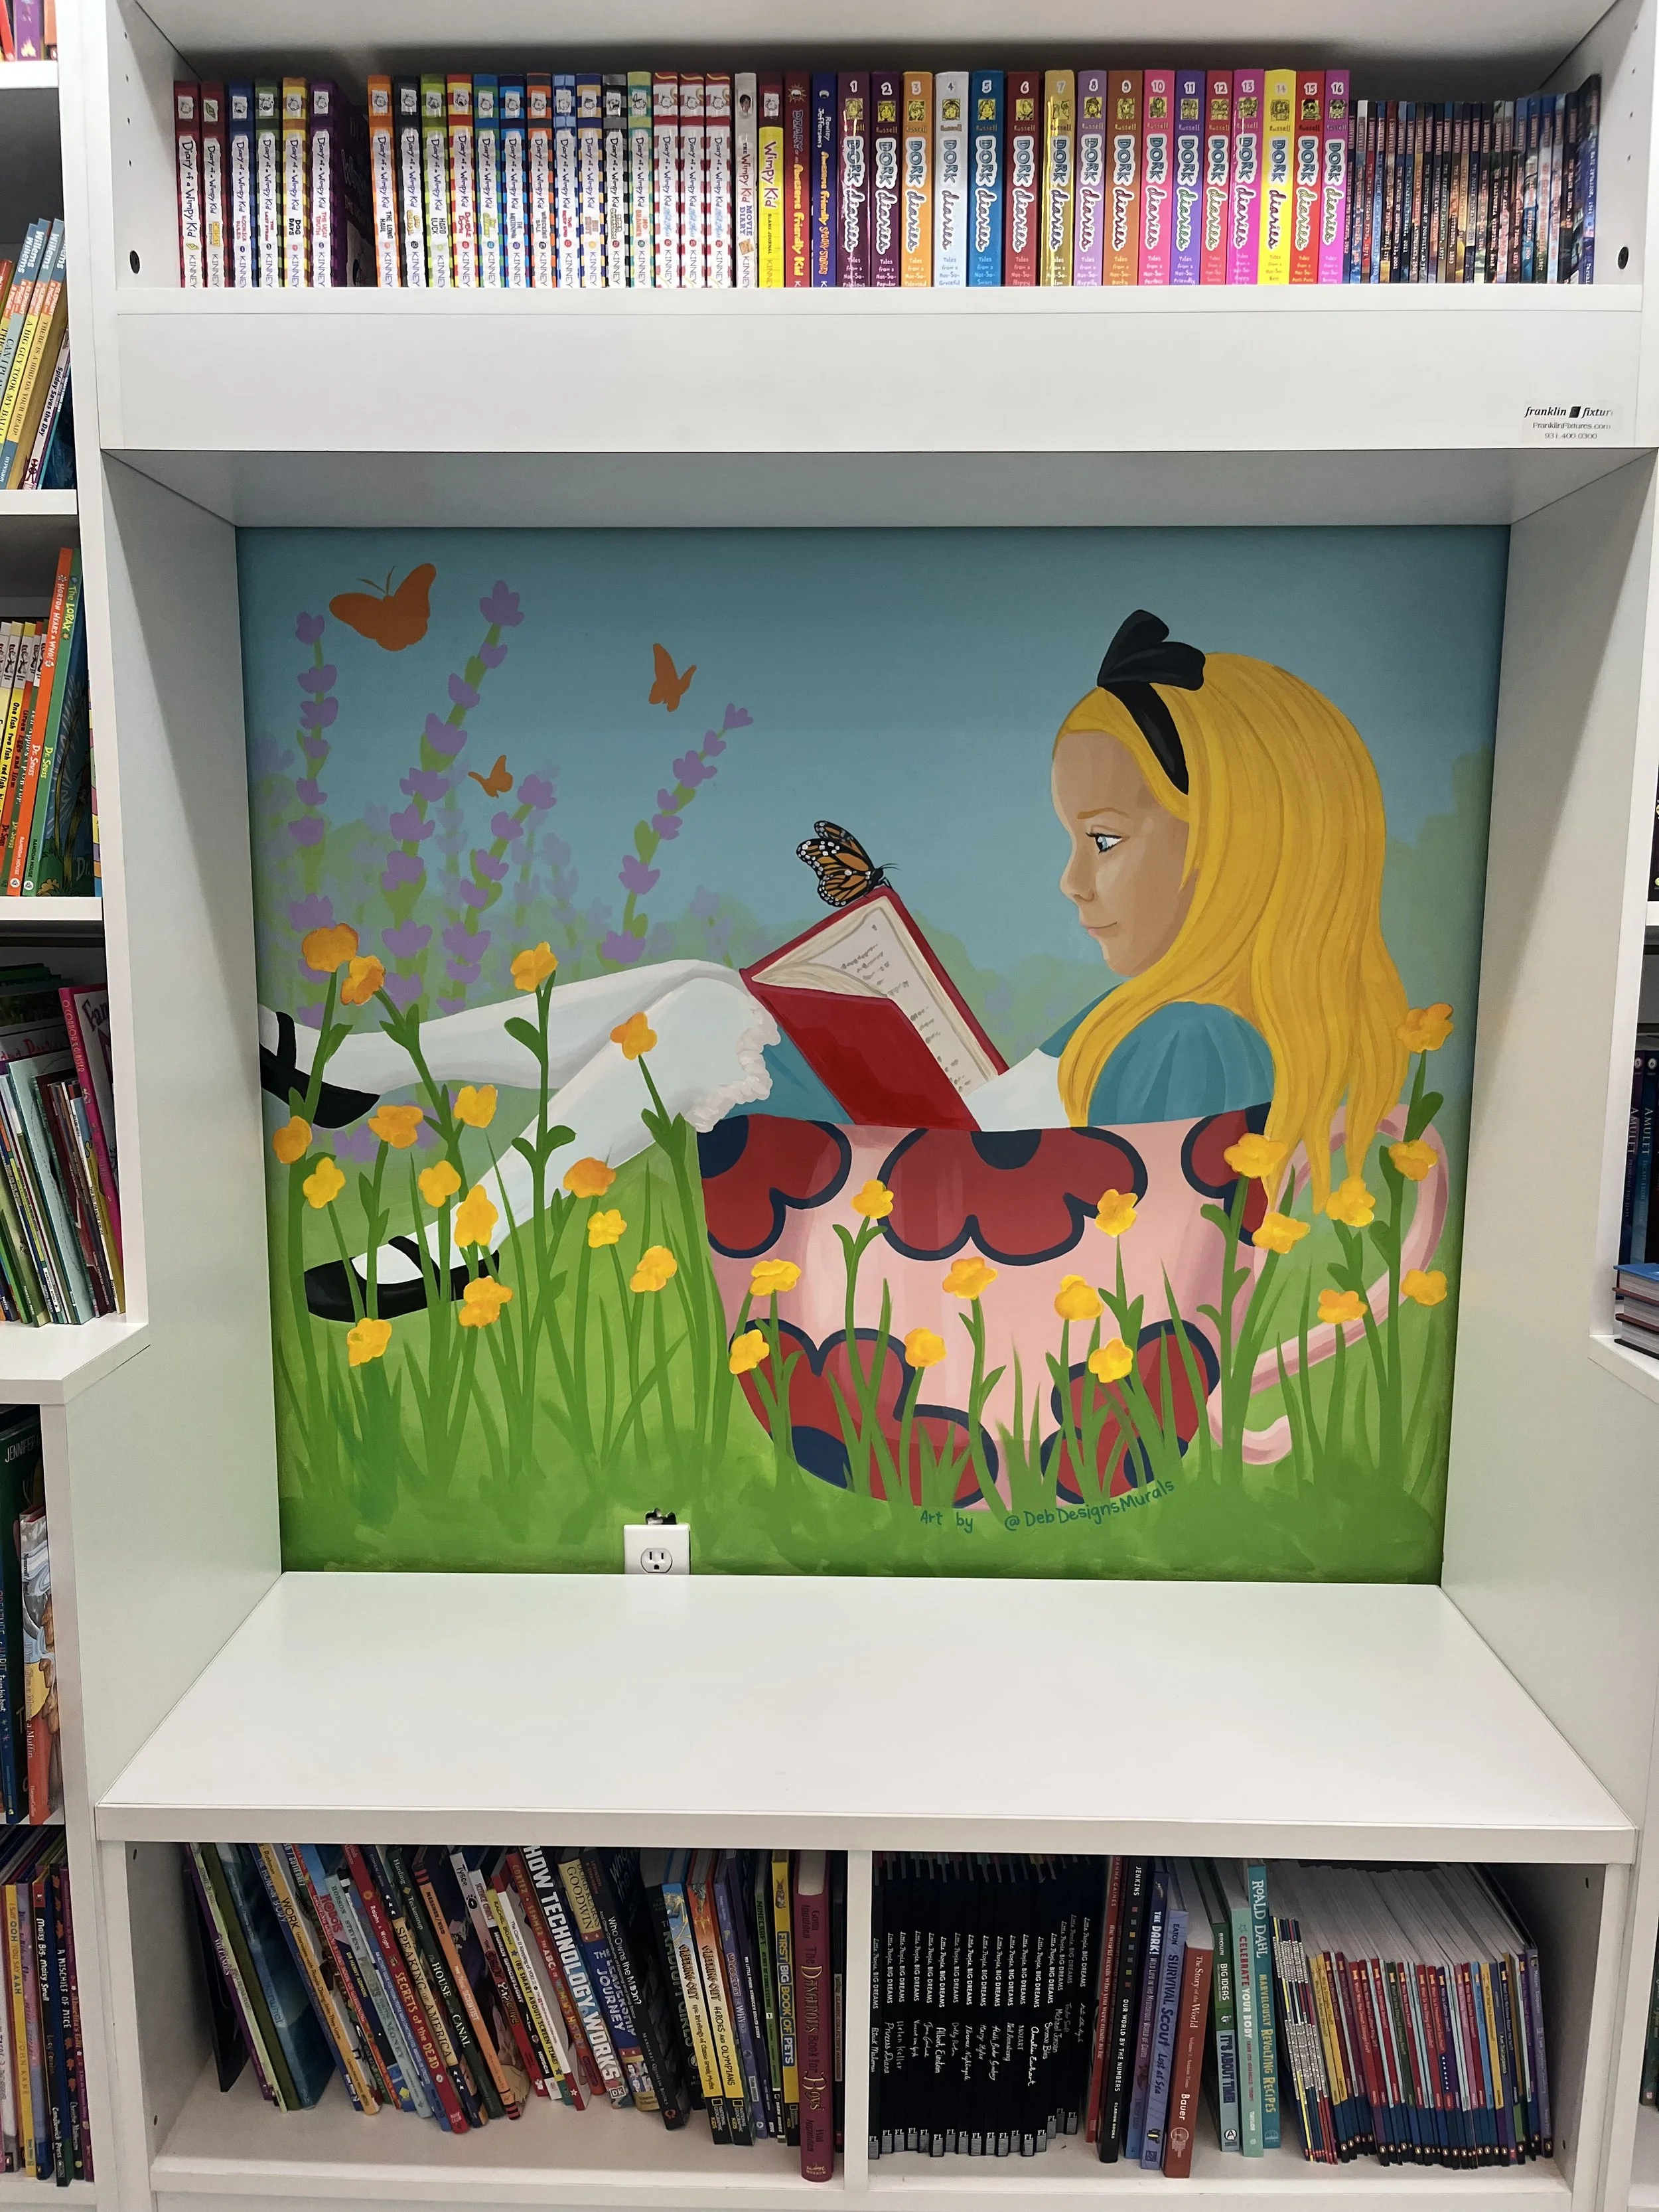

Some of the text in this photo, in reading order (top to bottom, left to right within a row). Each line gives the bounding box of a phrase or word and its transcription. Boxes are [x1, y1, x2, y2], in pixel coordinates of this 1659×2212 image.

[883, 84, 891, 94] 2
[912, 83, 920, 93] 3
[983, 82, 989, 92] 5
[1021, 82, 1028, 92] 6
[1123, 82, 1129, 92] 9
[1185, 82, 1194, 92] 11
[1115, 122, 1136, 131] Russell
[181, 141, 194, 169] Diary
[378, 137, 386, 157] Diary
[378, 172, 388, 194] Wimpy
[739, 154, 751, 185] Wimpy
[761, 141, 778, 208] Wimpy Kid
[741, 188, 751, 202] Kid
[793, 163, 803, 209] Awesome
[877, 141, 897, 252] DORK diaries
[907, 140, 925, 251] DORK diaries
[977, 139, 995, 251] DORK diaries
[1015, 139, 1033, 251] DORK diaries
[1114, 138, 1132, 250] DORK diaries
[1178, 139, 1196, 250] DORK diaries
[182, 188, 196, 220] Wimpy
[186, 222, 197, 238] Kid
[17, 236, 34, 274] Willems
[27, 230, 44, 268] Willems
[40, 232, 60, 270] Willems
[188, 254, 197, 288] KINNEY
[794, 256, 804, 275] Kid
[21, 329, 30, 344] BIG
[36, 321, 49, 345] THERE
[15, 346, 26, 364] GUY
[8, 366, 21, 392] TOOK
[24, 382, 31, 391] ON
[50, 366, 64, 389] Spidey
[3, 393, 13, 408] MY
[18, 393, 29, 412] YOUR
[46, 390, 57, 410] Saves
[1524, 406, 1613, 419] franklin fixtur
[11, 413, 23, 435] HEAD!
[38, 423, 48, 437] Day
[54, 583, 64, 610] HORTON
[62, 585, 76, 631] The LORAX
[50, 613, 60, 634] HEARS
[46, 640, 55, 659] WHO!
[27, 757, 38, 776] Seuss
[39, 759, 51, 778] Seuss
[1627, 1107, 1639, 1154] AMULET
[1642, 1107, 1653, 1155] AMULET
[920, 1510, 943, 1525] Art
[956, 1512, 974, 1533] by
[1133, 1866, 1141, 1895] JENKINS
[565, 1865, 594, 1930] GOODWIN
[281, 1897, 300, 1930] WORK
[1252, 1880, 1269, 1957] ROALD DAHL
[36, 1917, 45, 1941] Maisy
[1149, 1925, 1161, 1954] DARK!
[396, 1925, 426, 1991] SPEAKING
[607, 1916, 632, 1975] Who Owns the
[57, 1957, 68, 1992] MISCHIEF
[524, 1846, 622, 2082] HOW TECHNOLOGY WORKS
[38, 1959, 49, 2001] Maisy Small
[431, 1961, 452, 1998] HOUSE
[1163, 1954, 1179, 2006] SURVIVAL
[1220, 1978, 1230, 2000] IDEAS
[1238, 1936, 1252, 2038] CELEBRATE YOUR BODY
[61, 1996, 69, 2006] OF
[778, 1933, 793, 2063] FIRST BIG BOOK OF PETS
[62, 2009, 71, 2028] MICE
[394, 1970, 440, 2069] SECRETS of the DEAD
[424, 2002, 452, 2058] AMERICA
[451, 2013, 471, 2047] CANAL
[713, 2006, 725, 2032] HEROES
[721, 2045, 735, 2086] OLYMPIANS
[883, 2022, 893, 2073] Princess Diana
[935, 2027, 946, 2047] Albert
[1258, 1974, 1277, 2112] MARVELOUSLY REVOLTING RECIPES
[1114, 2061, 1123, 2091] NUMBERS
[1177, 2093, 1190, 2120] Bauer
